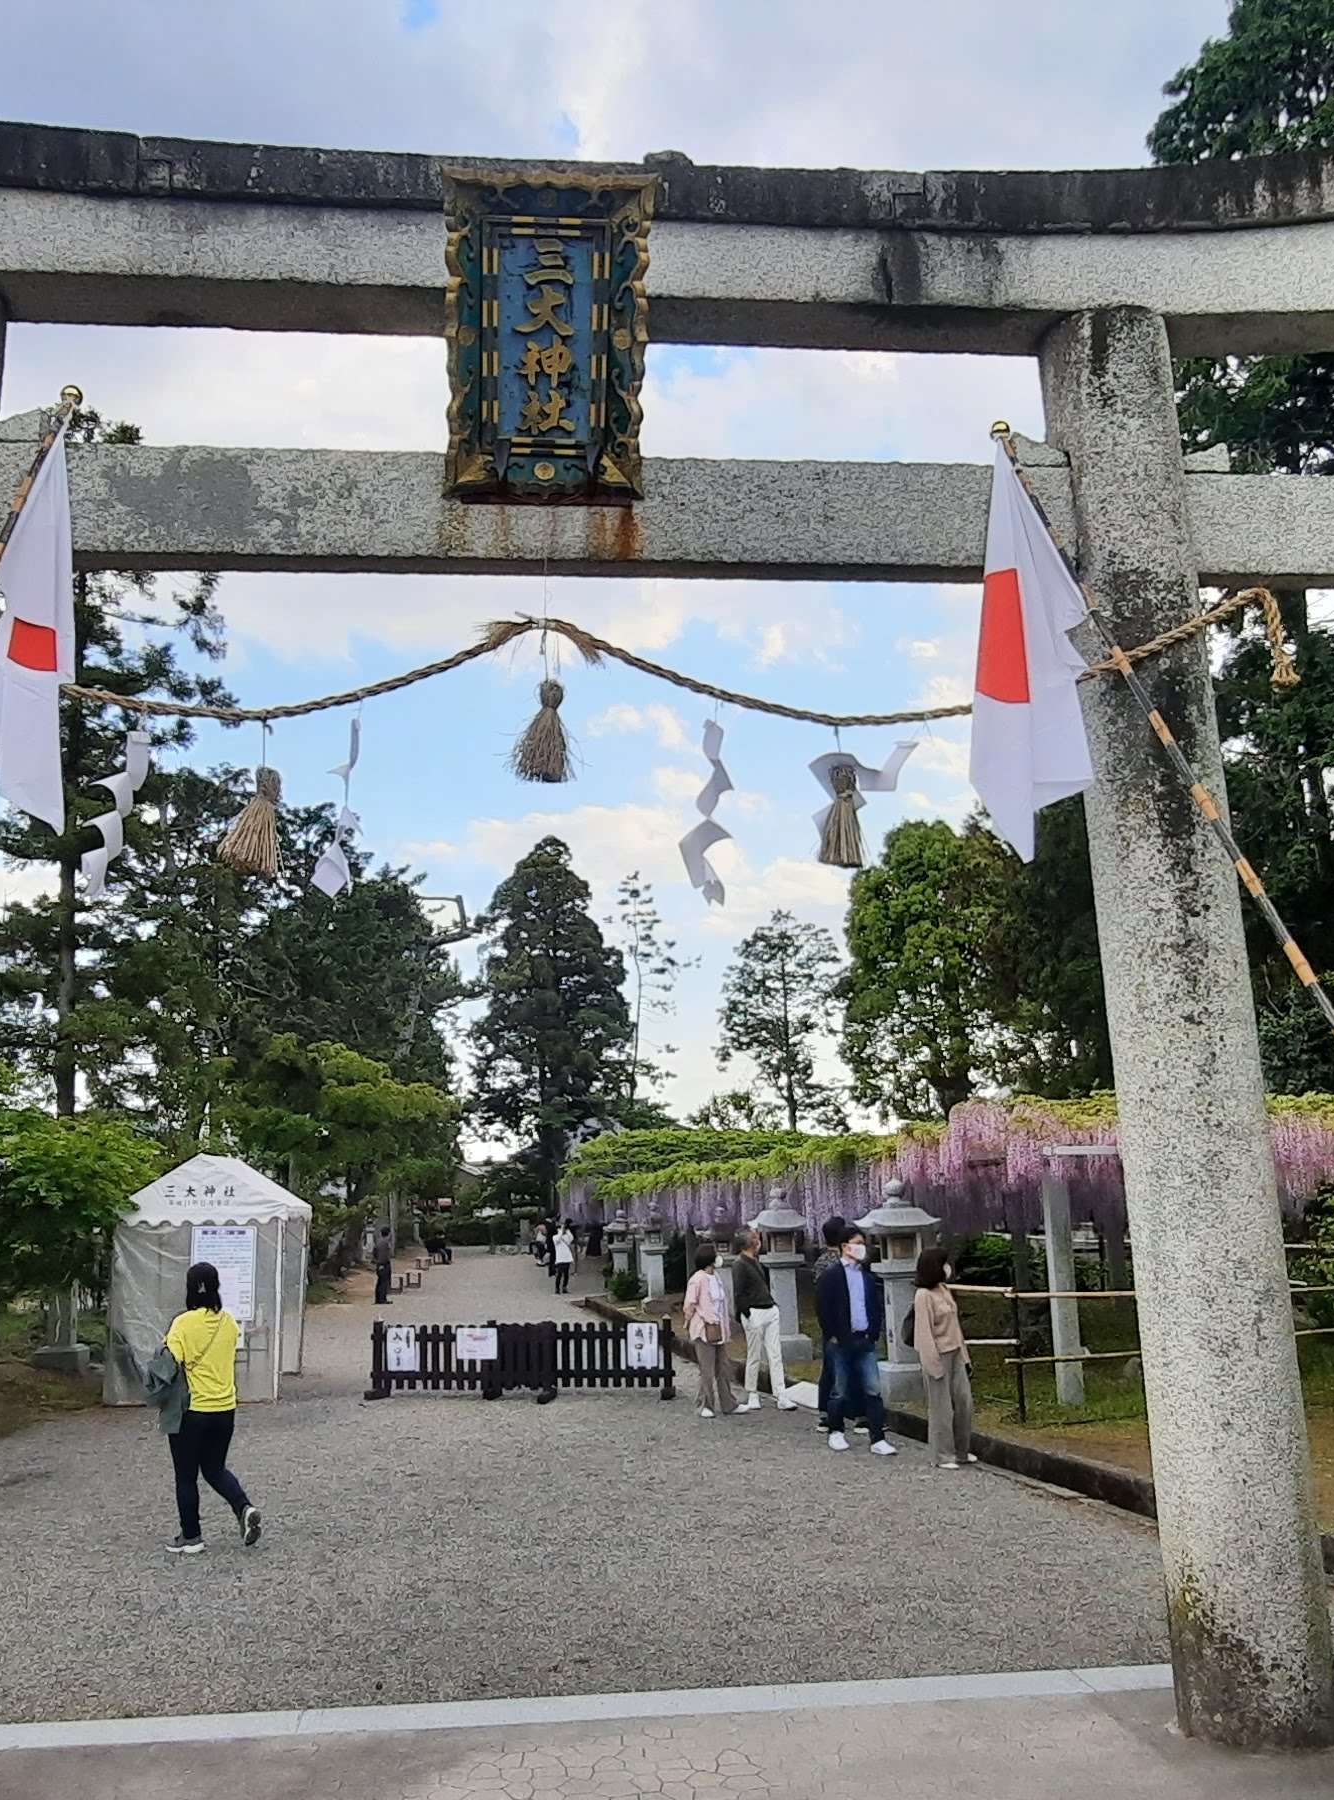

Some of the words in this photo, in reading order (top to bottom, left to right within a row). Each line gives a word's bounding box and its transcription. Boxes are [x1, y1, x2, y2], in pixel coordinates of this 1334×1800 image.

[514, 238, 575, 436] 三大神社
[164, 1184, 235, 1198] 三大神社
